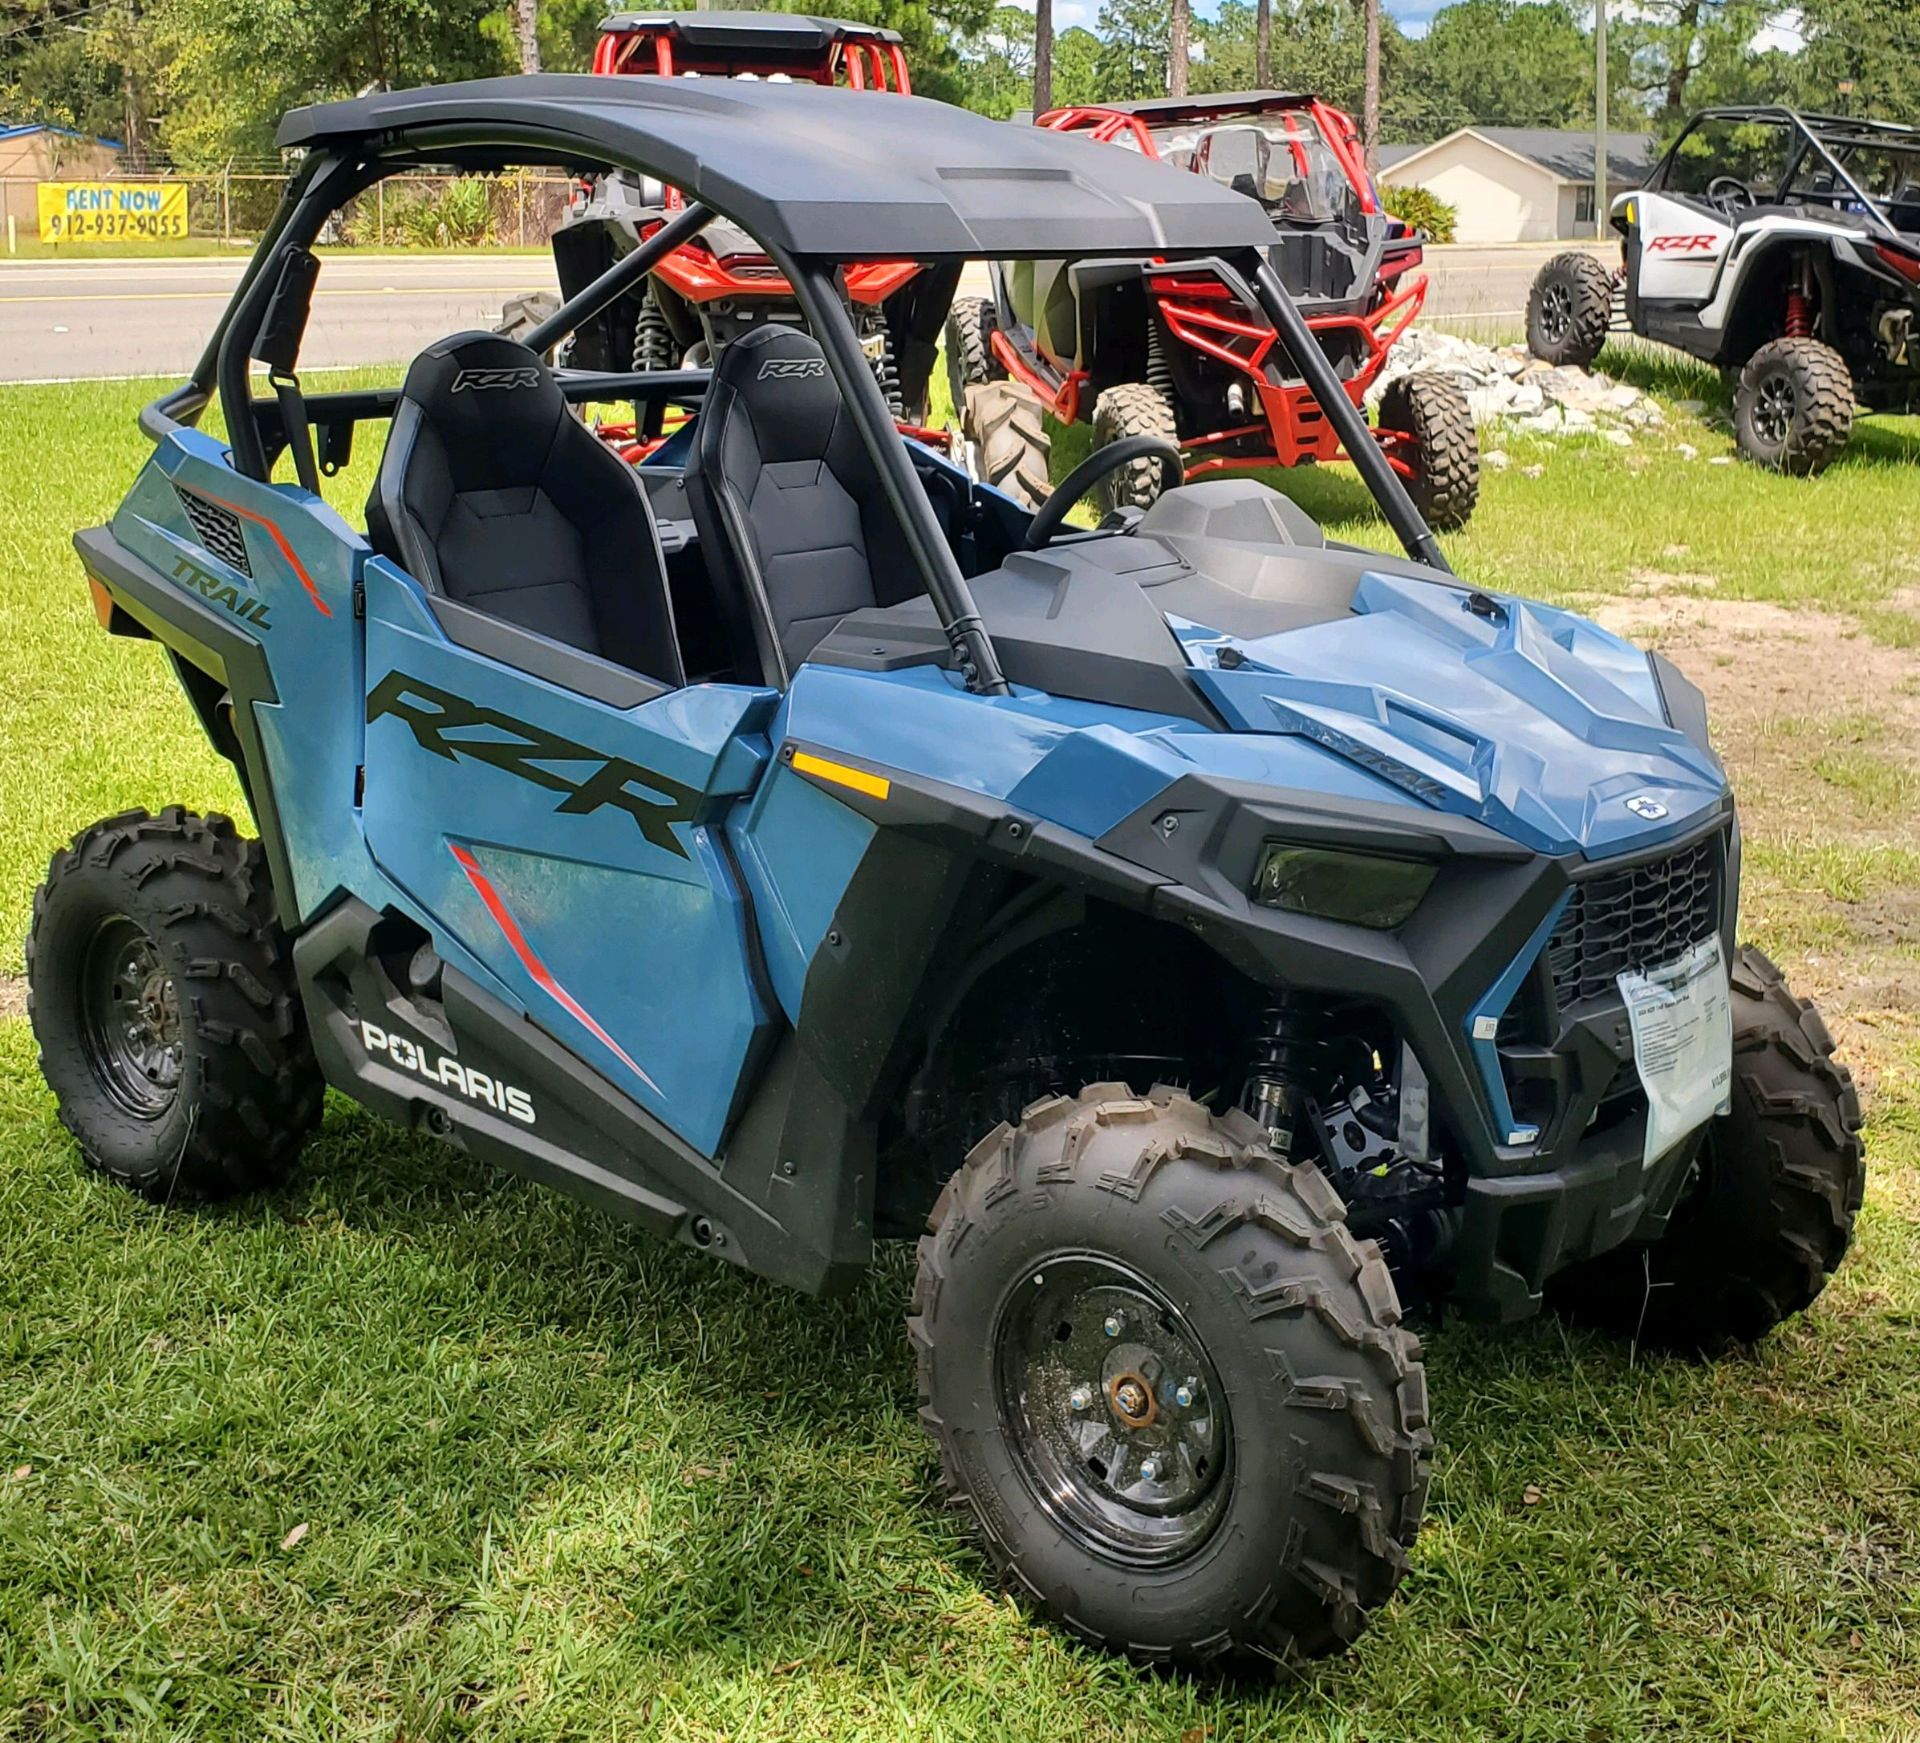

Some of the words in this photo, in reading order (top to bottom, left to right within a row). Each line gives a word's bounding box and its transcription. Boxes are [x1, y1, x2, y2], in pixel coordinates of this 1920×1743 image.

[67, 189, 113, 210] RENT
[119, 190, 161, 211] NOW
[51, 214, 181, 236] 912-937-9055
[1646, 234, 1717, 253] RZR
[451, 367, 541, 393] RZR
[757, 358, 827, 381] RZR
[172, 555, 273, 630] TRAIL
[366, 669, 705, 861] RZR
[361, 1020, 537, 1125] POLARIS
